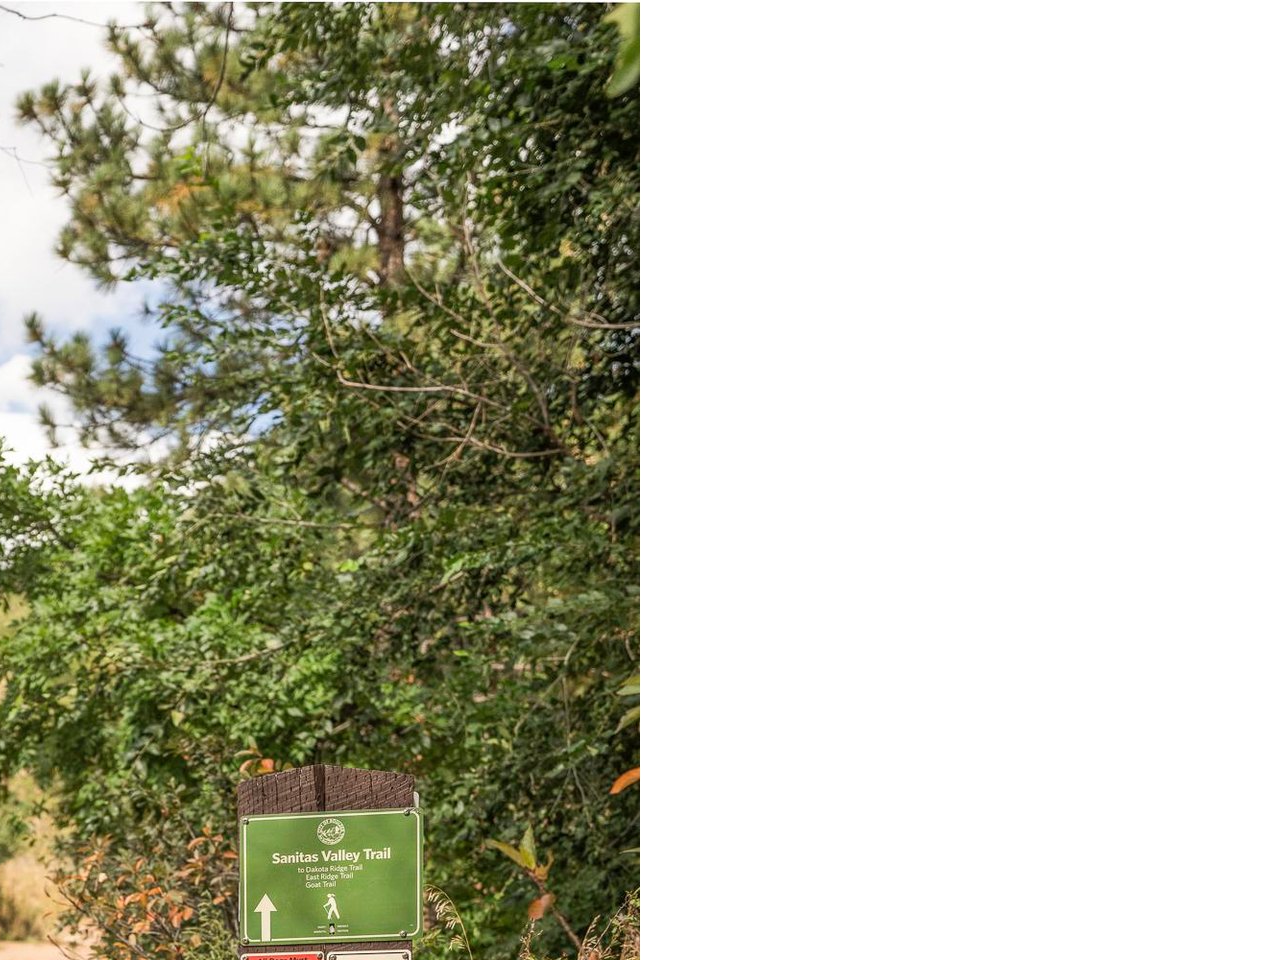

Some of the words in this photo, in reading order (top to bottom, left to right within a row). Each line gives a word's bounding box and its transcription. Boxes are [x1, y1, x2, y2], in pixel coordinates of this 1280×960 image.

[272, 852, 318, 864] Sanitas
[321, 850, 360, 863] Valley
[363, 848, 391, 860] Trail
